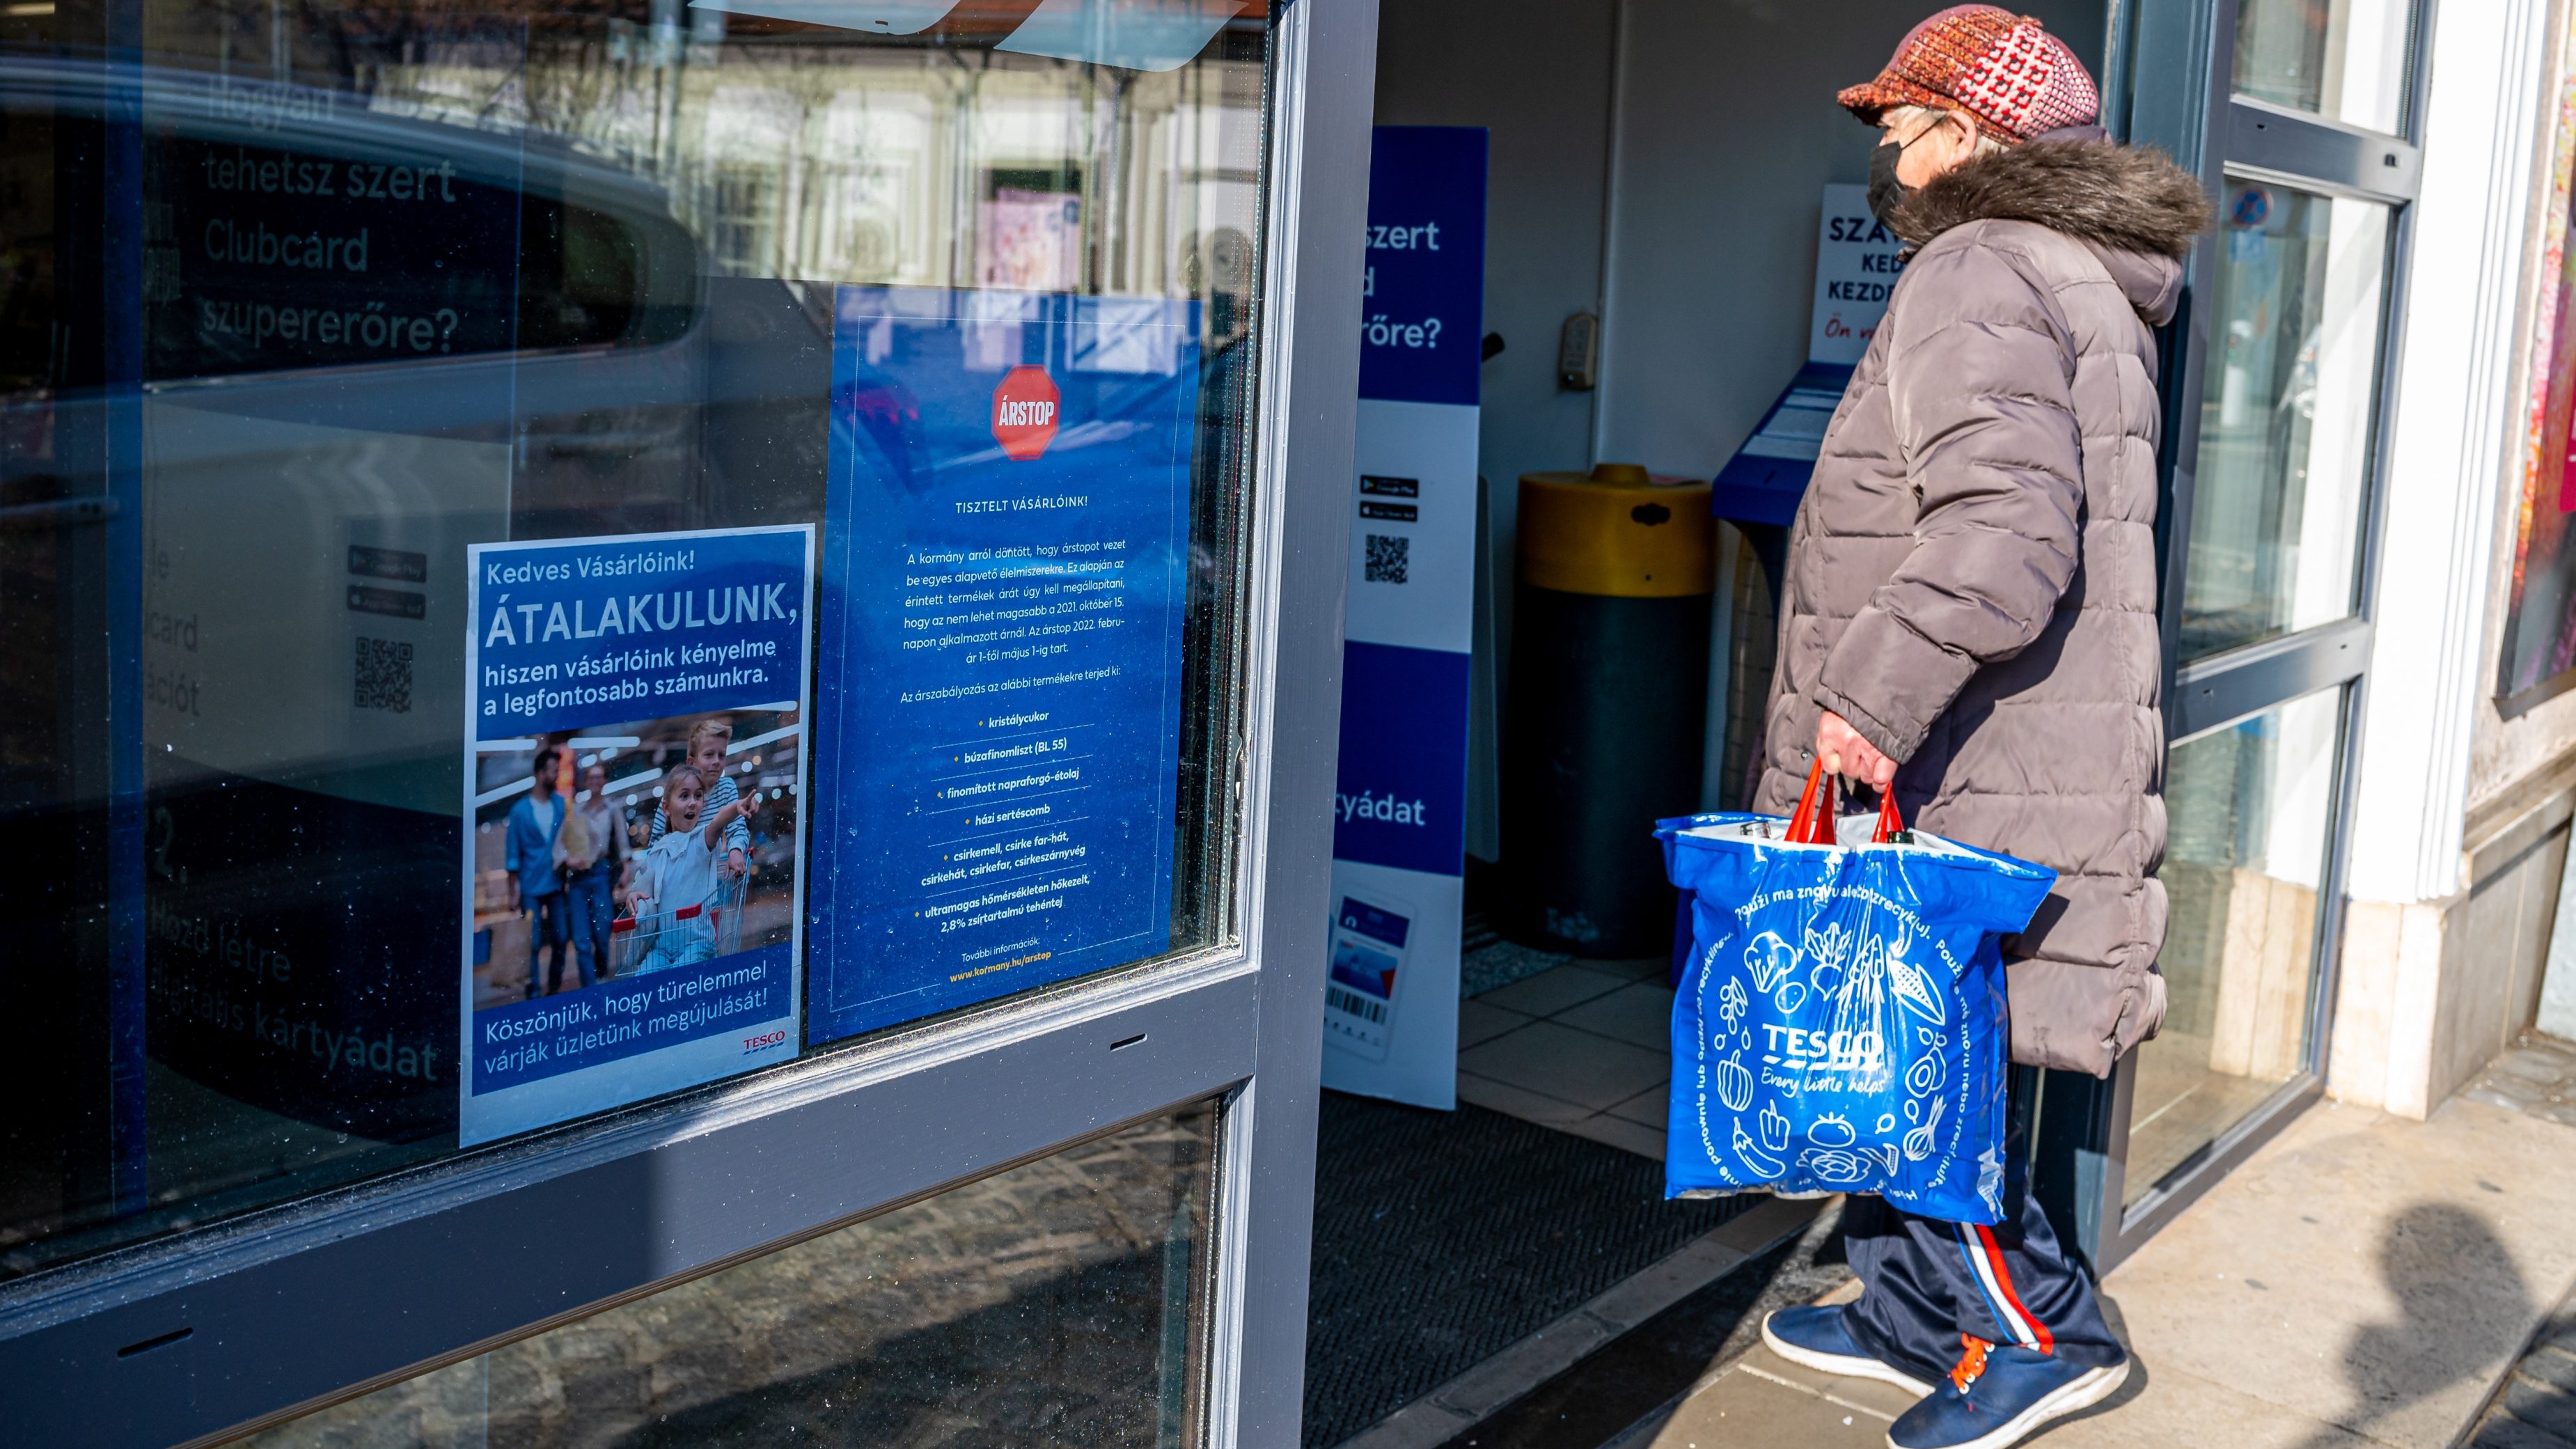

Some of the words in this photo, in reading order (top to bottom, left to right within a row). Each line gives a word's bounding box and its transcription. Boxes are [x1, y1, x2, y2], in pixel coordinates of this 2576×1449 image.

[207, 148, 335, 196] tehetsz
[347, 159, 457, 202] szert
[205, 218, 368, 272] Clubcard
[1830, 217, 1899, 242] SZA
[203, 299, 457, 352] szupererőre?
[998, 395, 1054, 426] ÁRSTOP
[956, 500, 1008, 513] TISZTELT
[1012, 494, 1088, 510] VÁSÁRLÓINK!
[487, 561, 570, 586] Kedves
[576, 550, 695, 579] Vásárlóink!
[907, 554, 916, 565] A
[920, 549, 964, 567] kormány
[968, 548, 991, 560] arról
[995, 545, 1032, 558] döntött,
[1037, 545, 1059, 557] hogy
[1062, 541, 1100, 556] árstopot
[1104, 539, 1126, 549] vezet
[906, 574, 919, 586] be
[922, 574, 952, 587] egyes
[955, 567, 998, 583] alapvető
[1000, 563, 1065, 579] élelmiszerekre.
[1067, 562, 1078, 573] Ez
[1080, 560, 1113, 574] alapján
[1115, 560, 1124, 570] az
[905, 595, 943, 607] érintett
[948, 591, 994, 604] termékek
[999, 588, 1019, 600] árát
[1023, 586, 1041, 598] úgy
[1044, 583, 1059, 595] kell
[1063, 579, 1125, 594] megállapítani,
[485, 582, 797, 648] ÁTALAKULUNK,
[904, 616, 929, 630] hogy
[932, 617, 943, 625] az
[946, 615, 968, 625] nem
[971, 609, 995, 622] lehet
[996, 604, 1046, 621] magasabb
[1057, 602, 1078, 613] 2021.
[1079, 599, 1113, 611] október
[1114, 597, 1124, 608] 15.
[903, 637, 936, 651] napon
[939, 631, 998, 648] alkalmazott
[1000, 627, 1027, 640] árnál.
[1028, 626, 1041, 636] Az
[1042, 622, 1071, 636] árstop
[1073, 620, 1095, 632] 2022.
[1098, 616, 1125, 629] febru-
[485, 661, 557, 687] hiszen
[565, 646, 675, 678] vásárlóink
[682, 639, 776, 668] kényelme
[966, 652, 977, 664] ár
[979, 648, 999, 662] 1-től
[1001, 647, 1030, 661] május
[1032, 645, 1049, 657] 1-ig
[1050, 643, 1069, 655] tart.
[483, 699, 497, 716] a
[504, 678, 648, 718] legfontosabb
[655, 667, 769, 696] számunkra.
[900, 691, 913, 703] Az
[915, 684, 986, 702] árszabályozás
[987, 683, 999, 693] az
[1000, 677, 1031, 691] alábbi
[1032, 671, 1083, 688] termékekre
[1085, 666, 1110, 681] terjed
[1111, 665, 1121, 676] ki:
[989, 711, 1050, 728] kristálycukor
[964, 744, 1033, 764] búzafinomliszt
[1035, 740, 1051, 755] (BL
[1052, 737, 1067, 751] 55)
[948, 781, 996, 799] finomított
[998, 767, 1080, 792] napraforgó-étolaj
[975, 812, 995, 826] házi
[996, 804, 1051, 821] sertéscomb
[953, 843, 1003, 862] csirkemell,
[1005, 837, 1032, 852] csirke
[1034, 831, 1069, 847] far-hát,
[920, 868, 968, 886] csirkehát,
[970, 860, 1012, 877] csirkefar,
[1014, 845, 1086, 868] csirkeszárnyvég
[925, 899, 980, 918] ultramagas
[982, 884, 1049, 906] hőmérsékleten
[1051, 874, 1090, 891] hőkezelt,
[1773, 889, 1794, 902] ma
[941, 918, 966, 934] 2,8%
[968, 904, 1024, 927] zsírtartalmú
[1026, 895, 1064, 914] tehéntej
[218, 921, 291, 982] létre
[950, 950, 1051, 982] www.kormany.hu/arstop
[961, 948, 993, 962] További
[994, 937, 1041, 955] információk:
[486, 1001, 597, 1044] Köszönjük,
[606, 990, 652, 1018] hogy
[657, 960, 767, 1003] türelemmel
[255, 1001, 438, 1081] kártyádat
[485, 1040, 549, 1074] várják
[556, 1019, 641, 1057] üzletünk
[648, 987, 768, 1036] megújulását!
[743, 1031, 786, 1051] TESCO
[1762, 1023, 1885, 1058] TESCO
[1697, 1065, 1706, 1088] lub
[1761, 1066, 1800, 1098] Every
[1803, 1074, 1843, 1093] little
[1847, 1075, 1885, 1099] helps
[1959, 1073, 1970, 1113] nebo
[1696, 1093, 1722, 1165] ponownie
